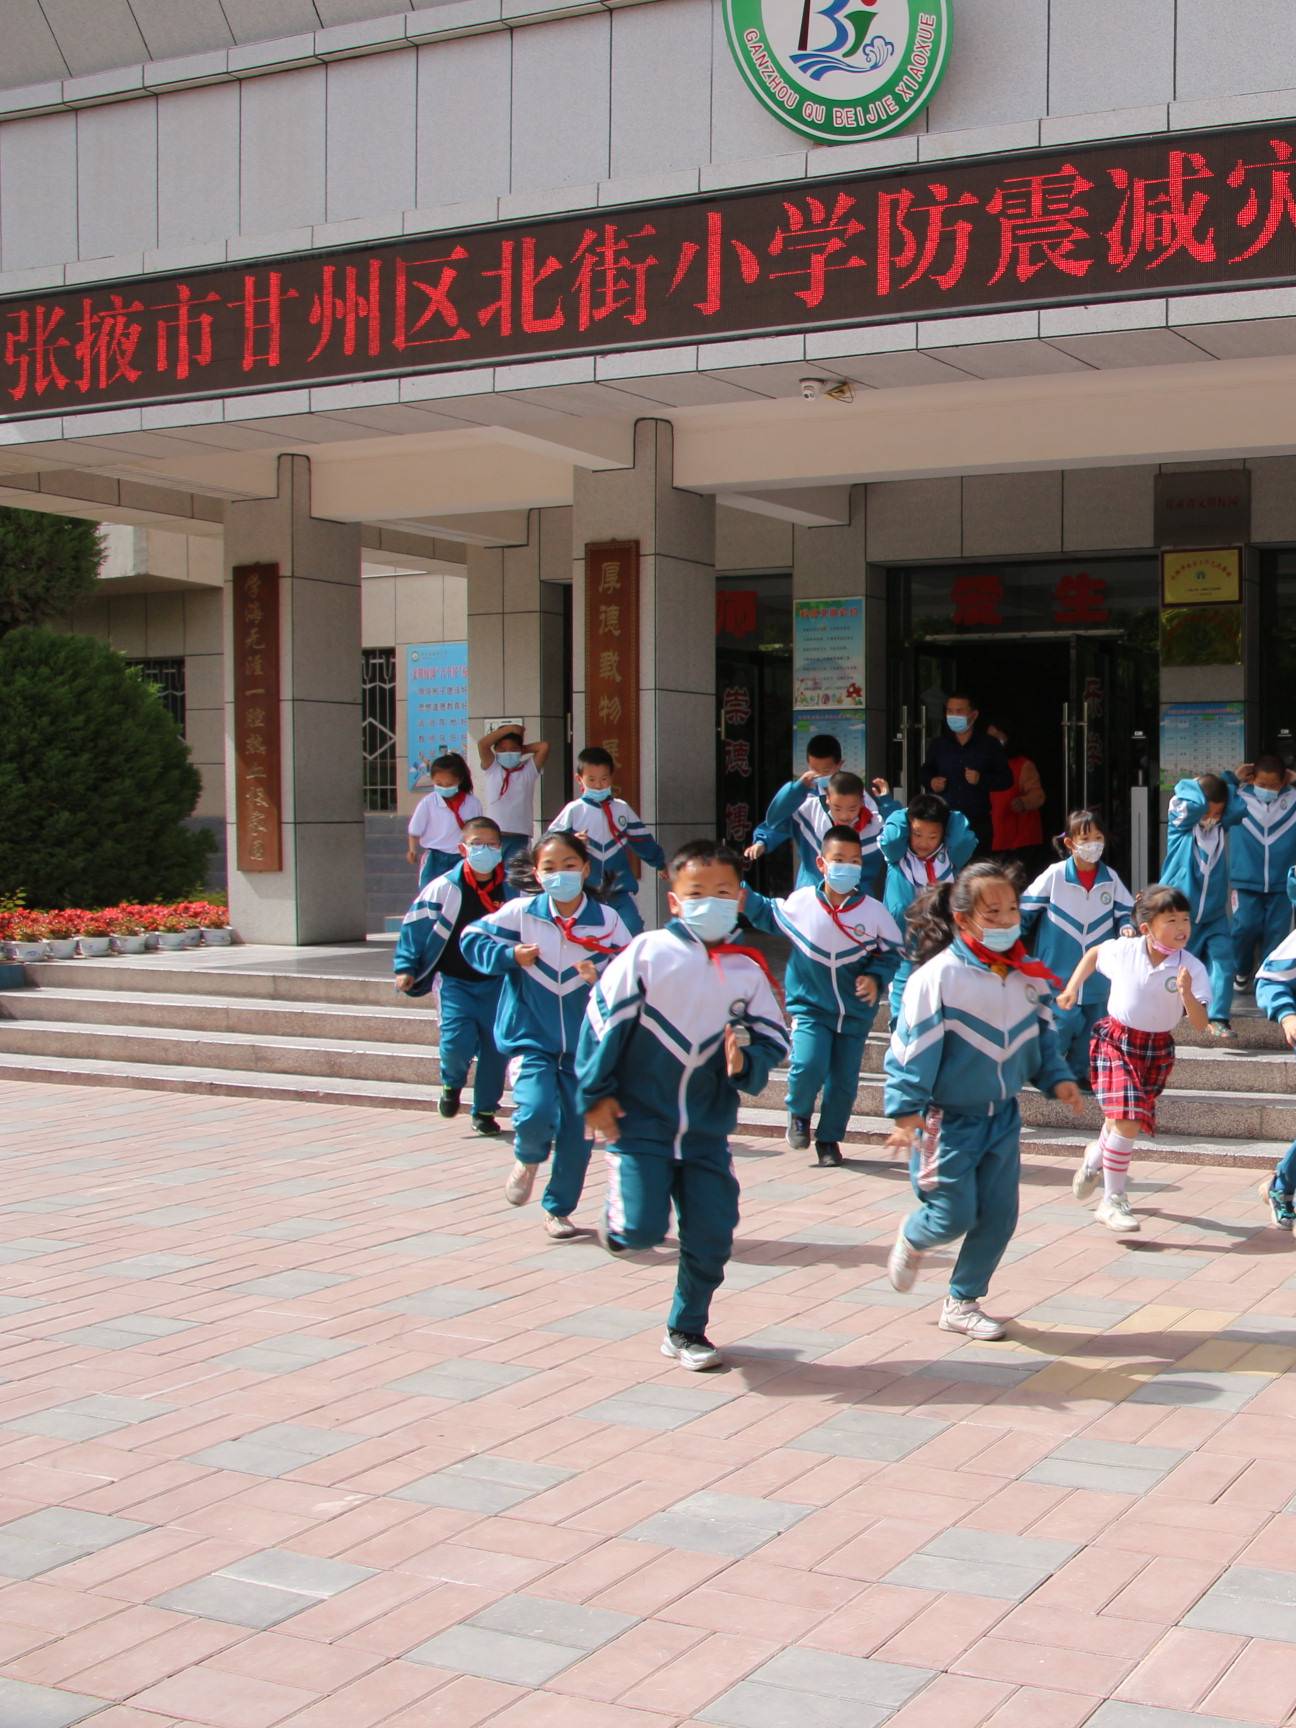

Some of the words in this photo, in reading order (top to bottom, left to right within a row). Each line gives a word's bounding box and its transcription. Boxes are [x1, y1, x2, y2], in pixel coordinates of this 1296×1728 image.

[744, 28, 799, 109] GANZHOU
[802, 101, 826, 124] QU
[833, 95, 899, 127] BEIJIE
[896, 13, 936, 102] XIAOXUE
[723, 686, 753, 871] 崇德博
